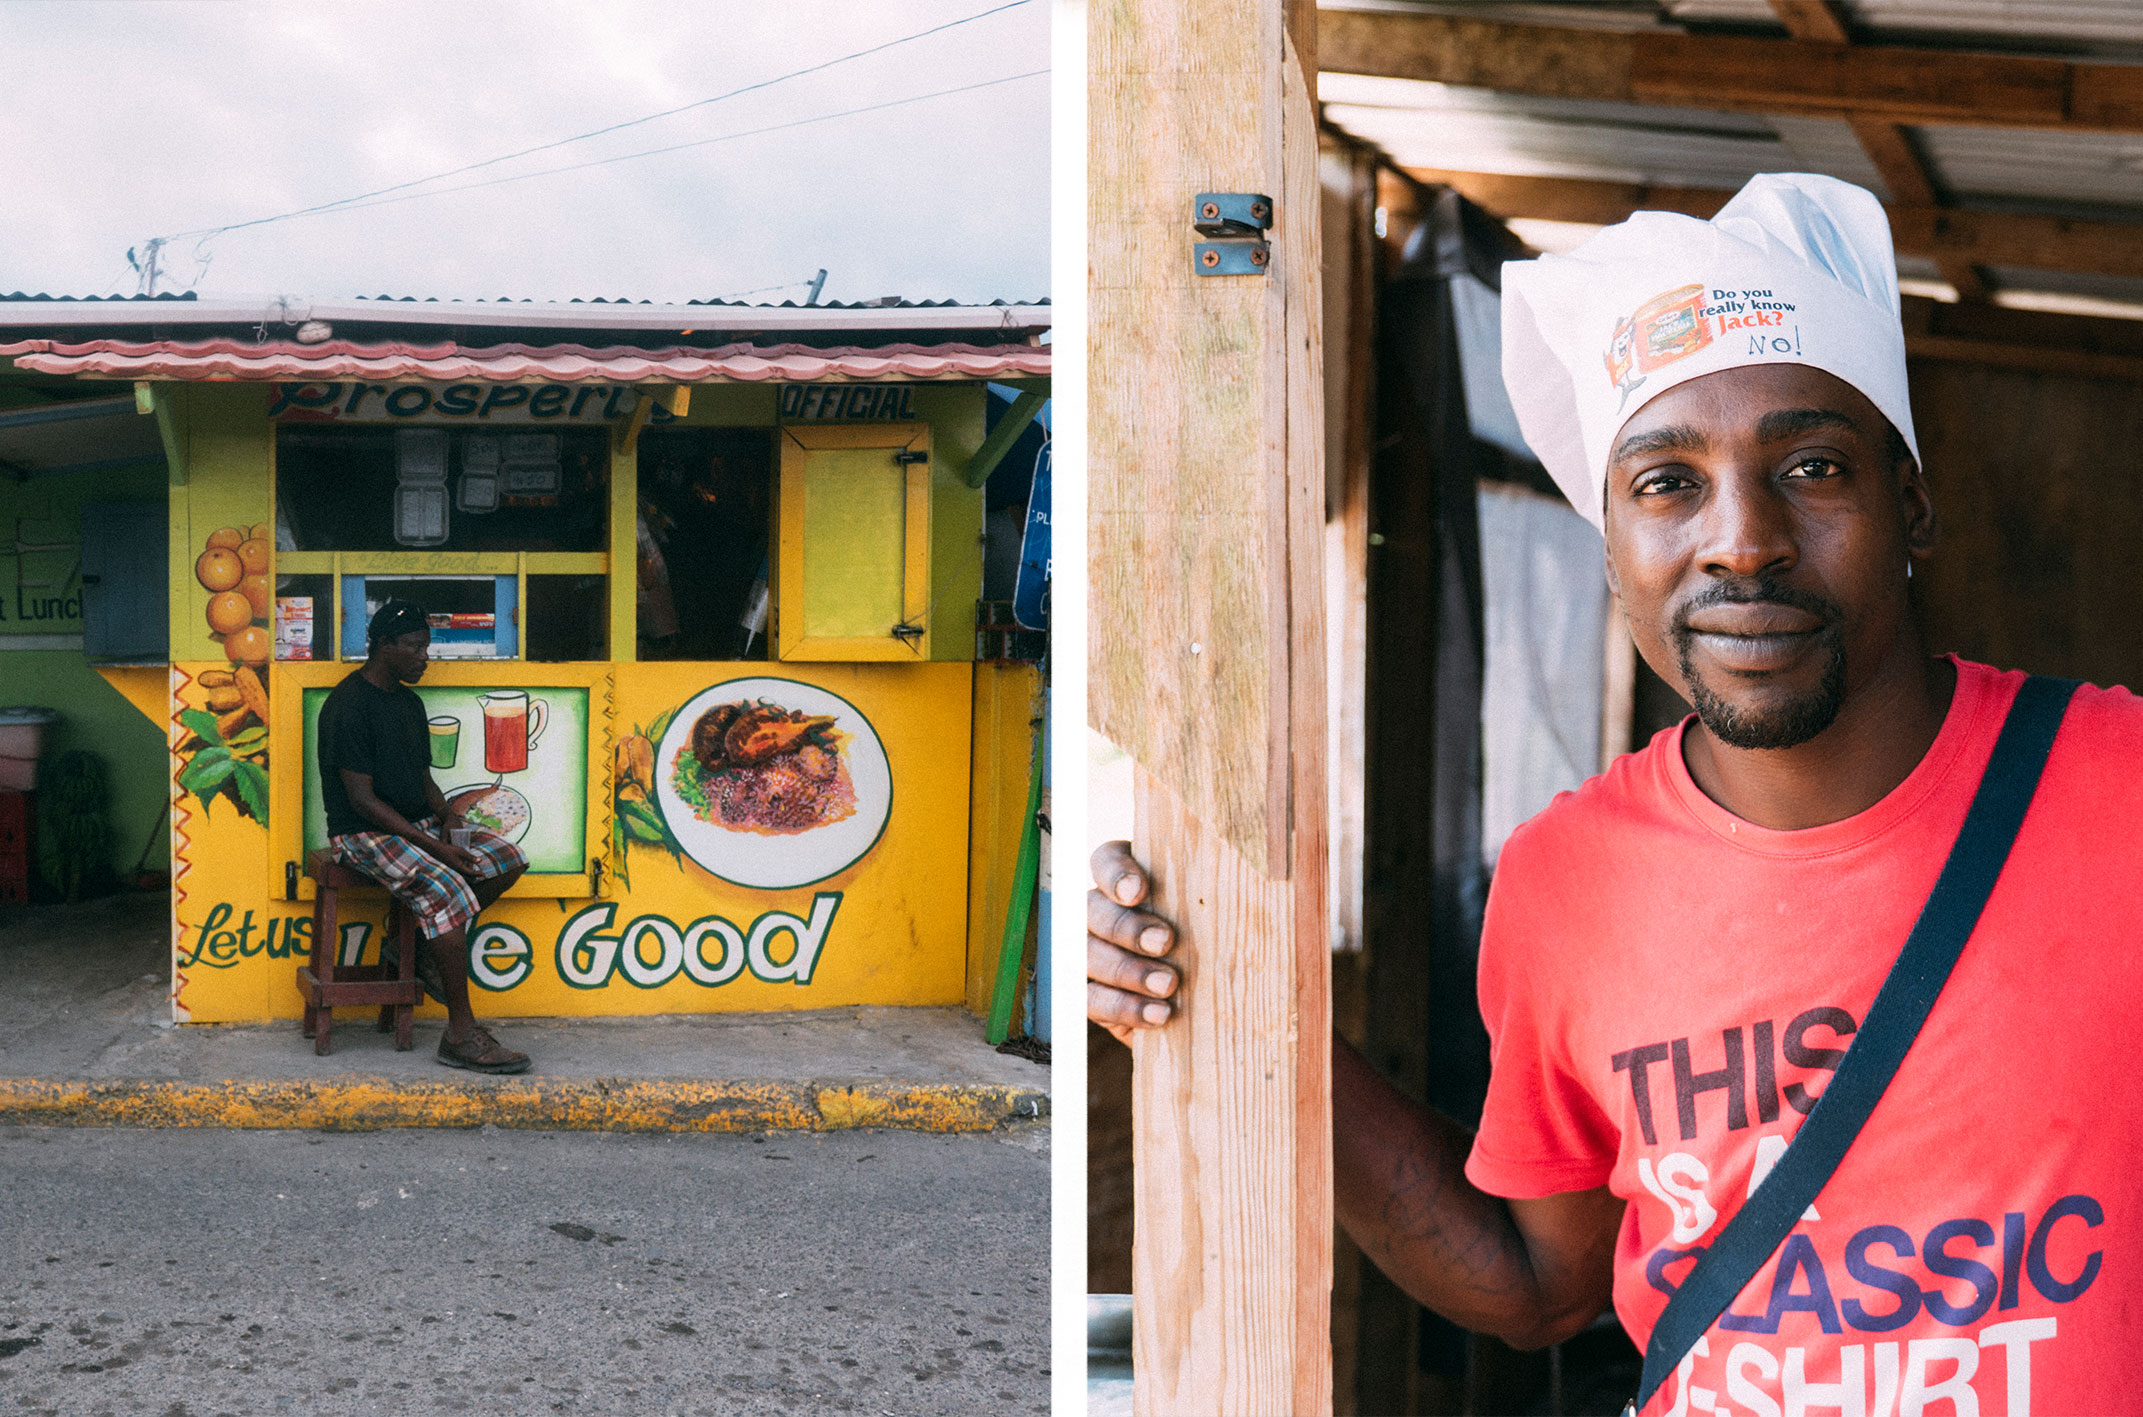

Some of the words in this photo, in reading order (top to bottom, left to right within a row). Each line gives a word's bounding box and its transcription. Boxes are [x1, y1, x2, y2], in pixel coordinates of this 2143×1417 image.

[1698, 301, 1746, 318] really
[1750, 299, 1796, 312] know
[1712, 288, 1737, 301] Do
[1741, 289, 1773, 300] you
[1719, 311, 1783, 336] Jack?
[781, 384, 916, 420] OFFICIAL
[183, 903, 265, 969] Let
[266, 916, 314, 959] us
[555, 892, 843, 989] Good
[1611, 1006, 1858, 1145] THIS
